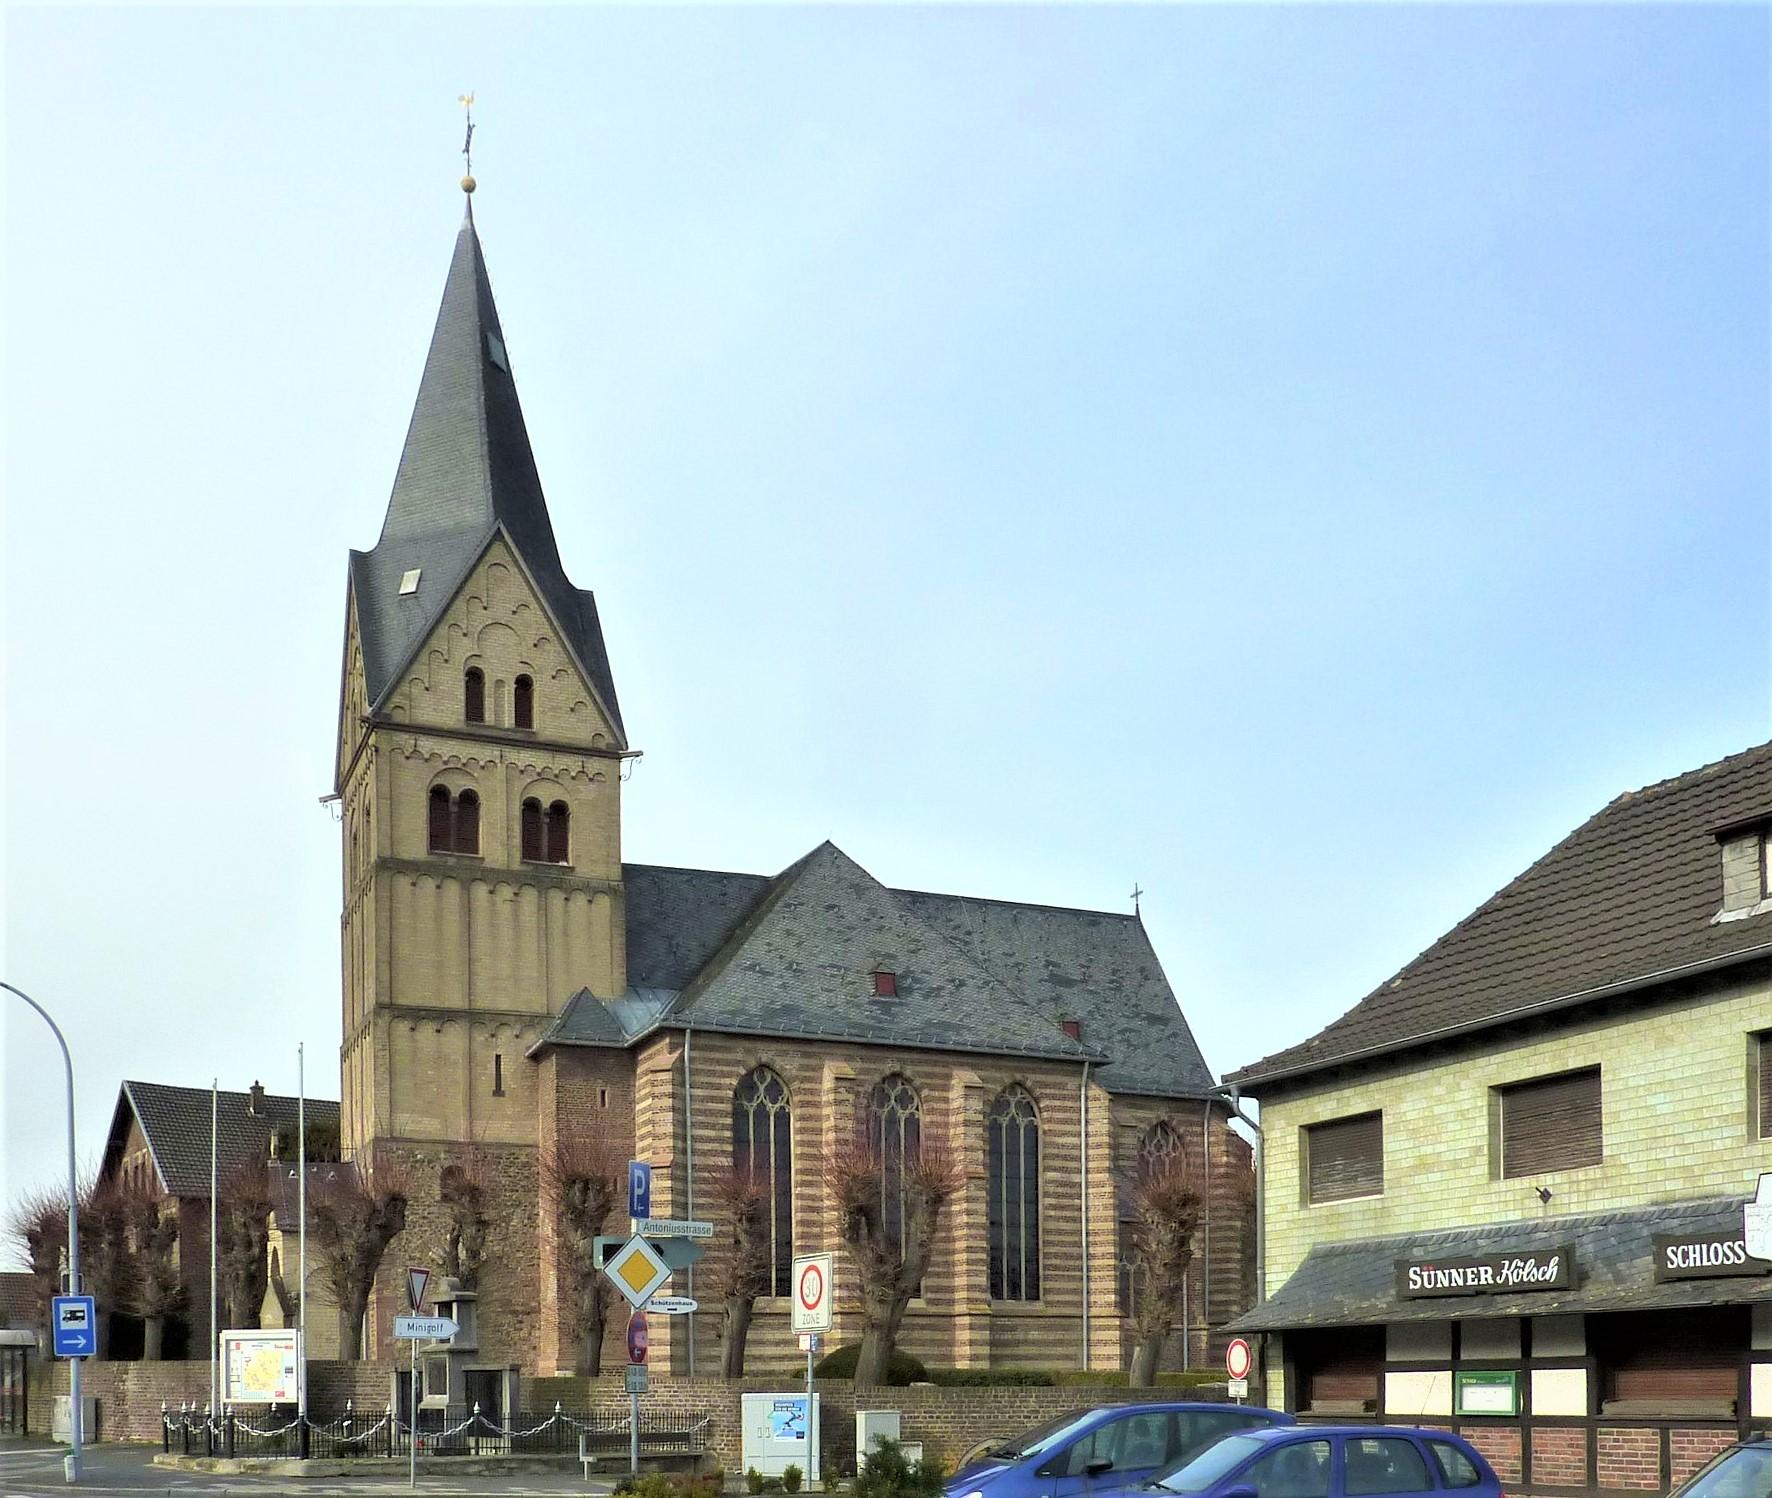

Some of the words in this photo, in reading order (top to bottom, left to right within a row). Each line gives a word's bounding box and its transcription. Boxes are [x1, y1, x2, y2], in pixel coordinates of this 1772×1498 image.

[633, 1168, 646, 1211] P
[643, 1222, 712, 1236] Antoniusstrasse
[1666, 1240, 1746, 1269] SCHLOSS
[1408, 1263, 1494, 1290] SÜNNER
[1496, 1255, 1560, 1286] Kölsch
[804, 1276, 818, 1298] 30
[407, 1322, 443, 1334] Minigolf
[801, 1312, 821, 1325] ZONE
